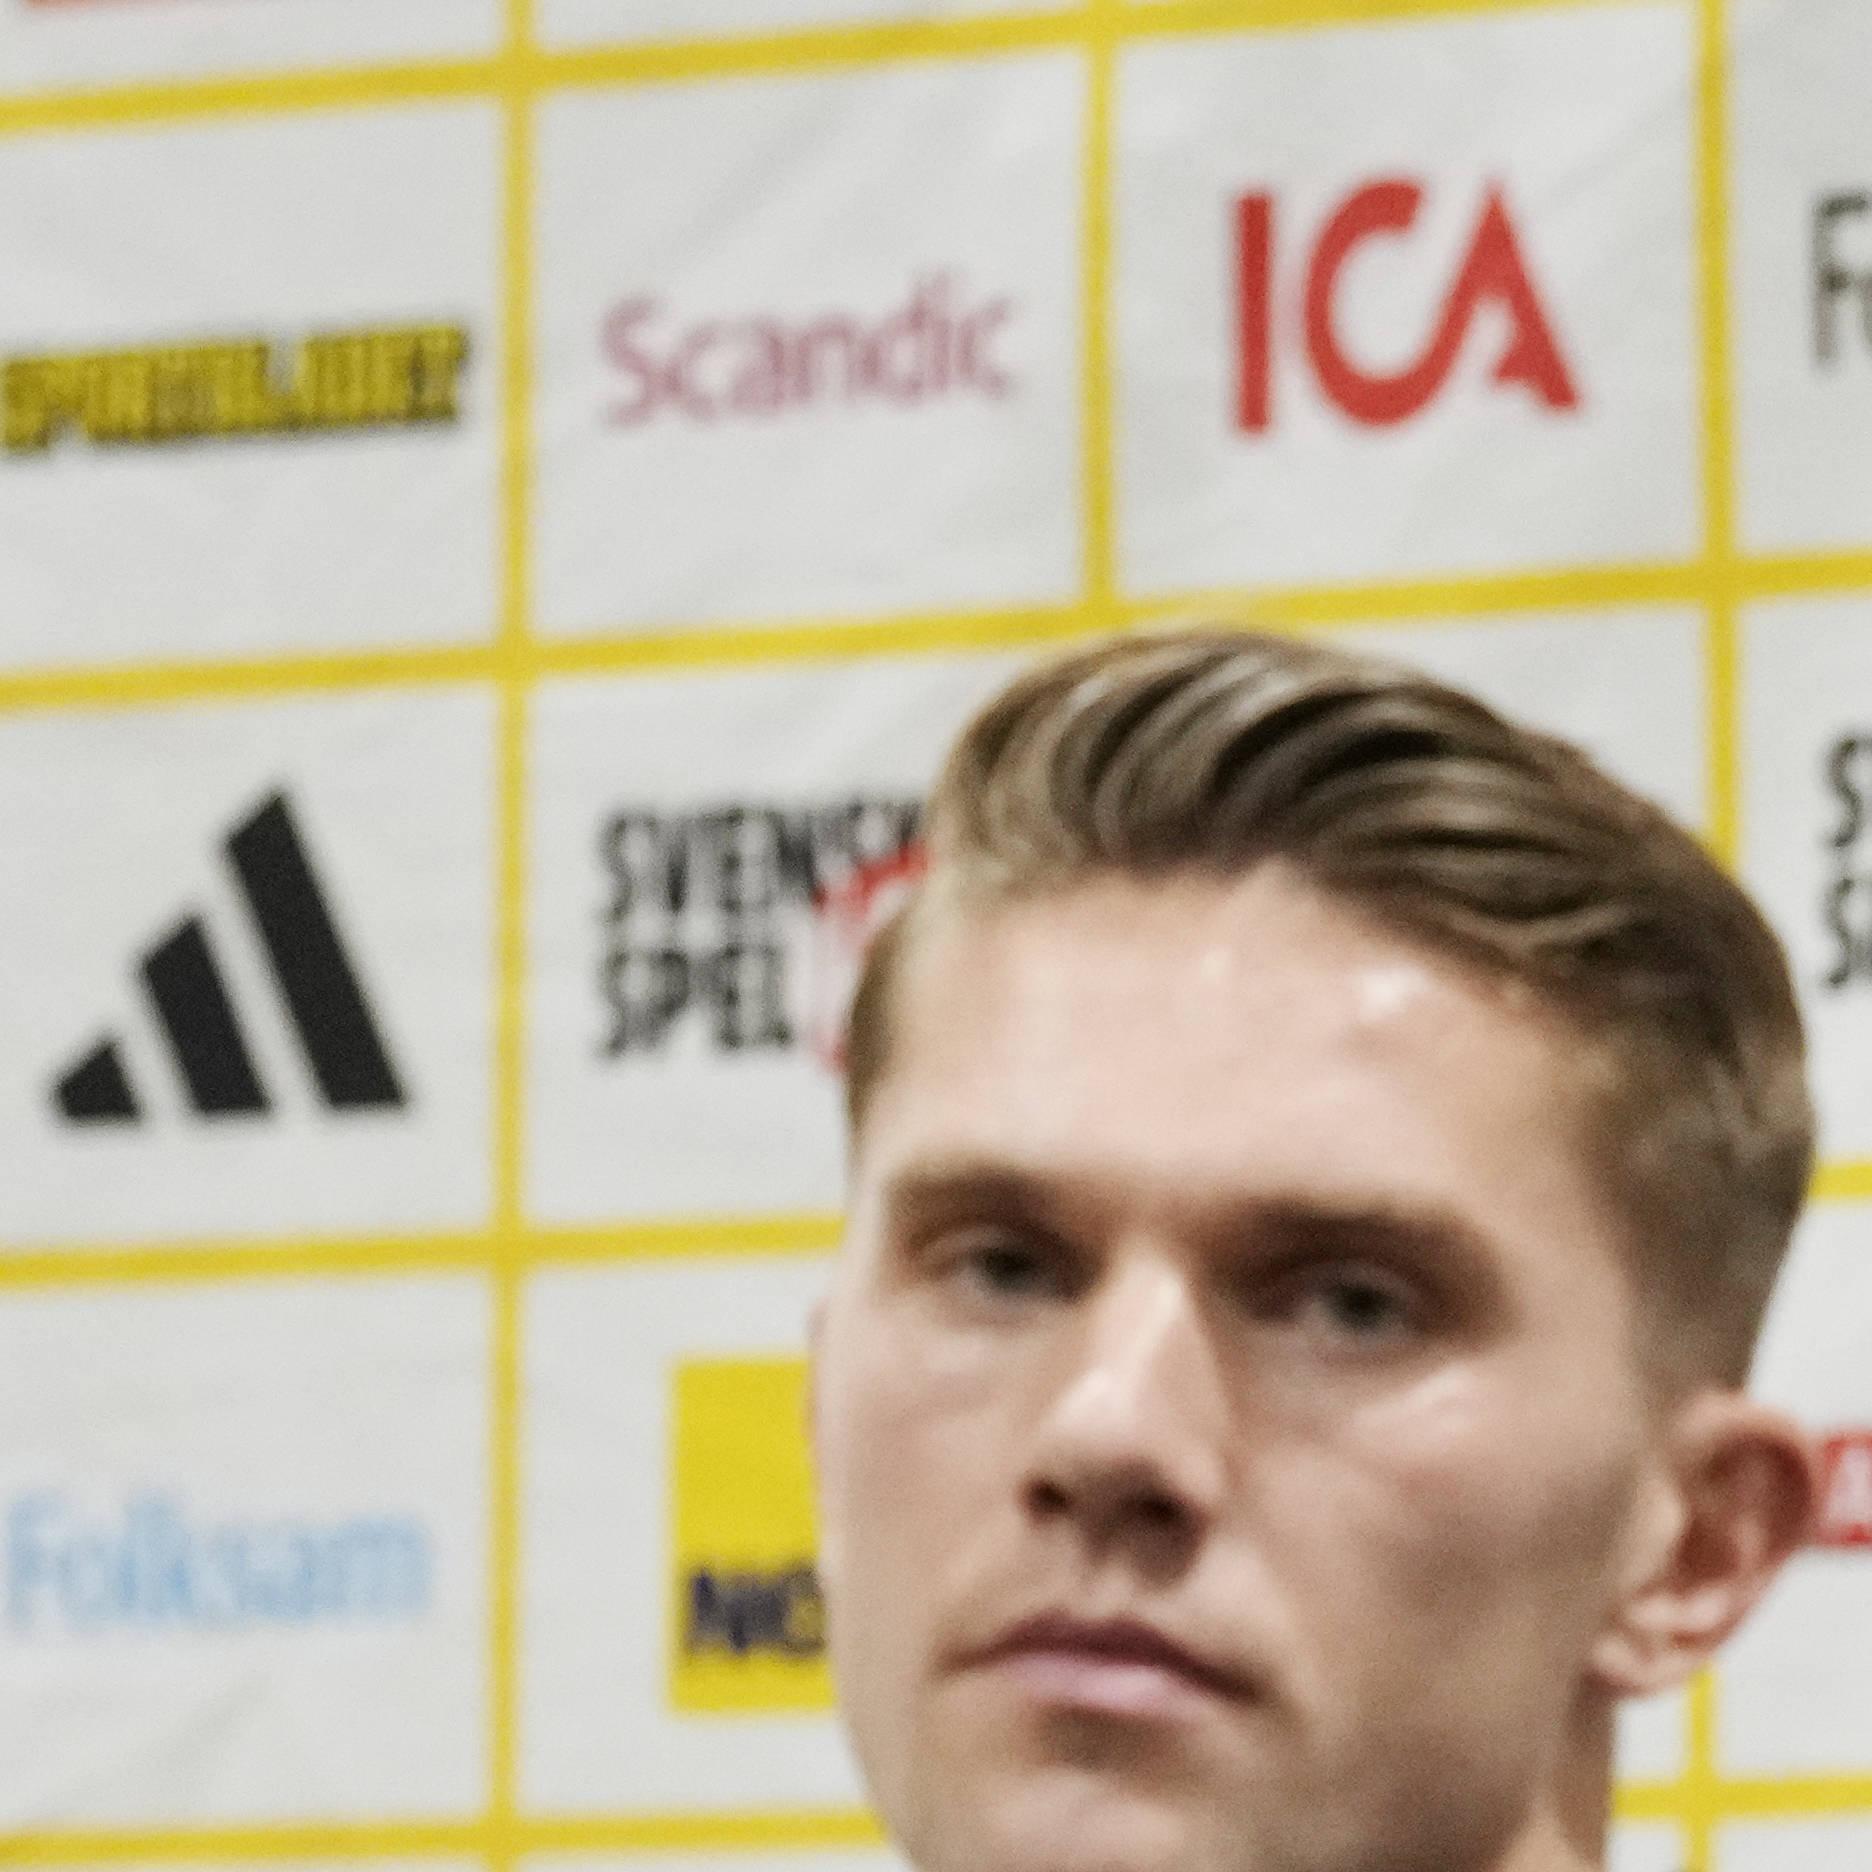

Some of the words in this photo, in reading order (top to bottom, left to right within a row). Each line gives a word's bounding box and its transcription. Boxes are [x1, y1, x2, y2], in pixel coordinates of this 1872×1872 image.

[605, 267, 1018, 428] Scandic
[1230, 173, 1581, 434] ICA
[602, 798, 925, 922] SVENSK
[600, 944, 796, 1058] SPEL
